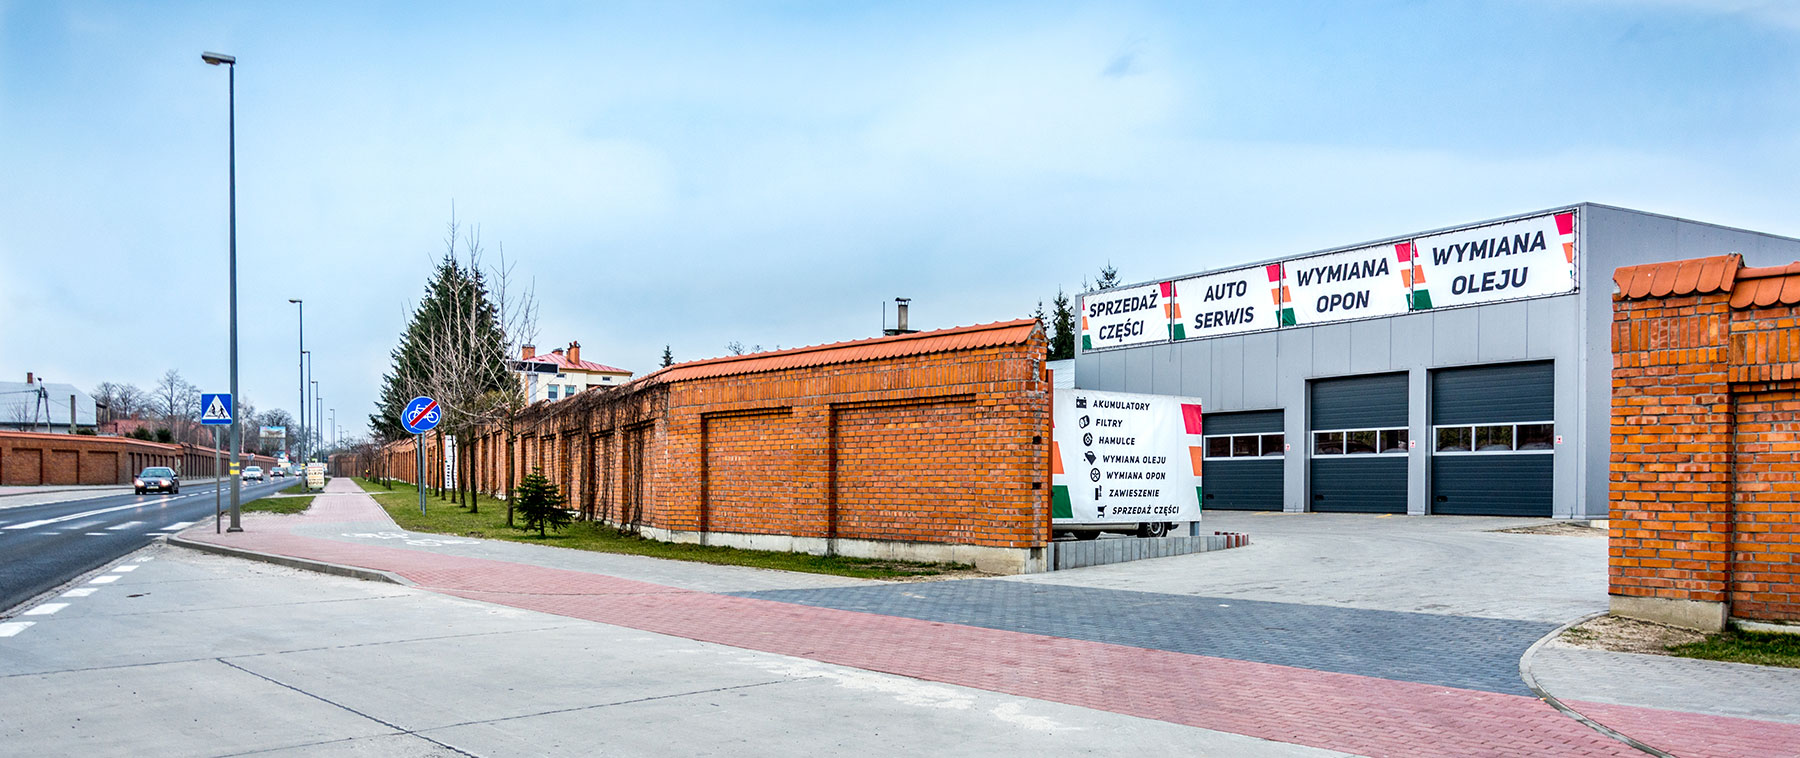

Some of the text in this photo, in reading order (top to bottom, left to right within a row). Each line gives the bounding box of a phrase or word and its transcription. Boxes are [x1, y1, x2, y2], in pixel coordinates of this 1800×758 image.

[1432, 230, 1547, 266] WYMIANA
[1296, 257, 1390, 287] WYMIANA
[1451, 266, 1528, 295] OLEJU
[1203, 280, 1247, 303] AUTO
[1316, 289, 1370, 313] OPON
[1089, 289, 1159, 318] SPRZEDAŻ
[1194, 306, 1255, 330] SERWIS
[1099, 318, 1144, 342] CZĘŚCI
[1092, 399, 1150, 411] AKUMULATORY
[1095, 418, 1123, 428] FILTRY
[1098, 436, 1136, 446] HAMULCE
[1103, 455, 1166, 465] WYMIANA OLEJU
[1106, 471, 1166, 480] WYMIANA OPON
[1108, 489, 1160, 498] ZAWIESZENIE
[1112, 504, 1180, 517] SPRZEDAŻ CZĘŚCI
